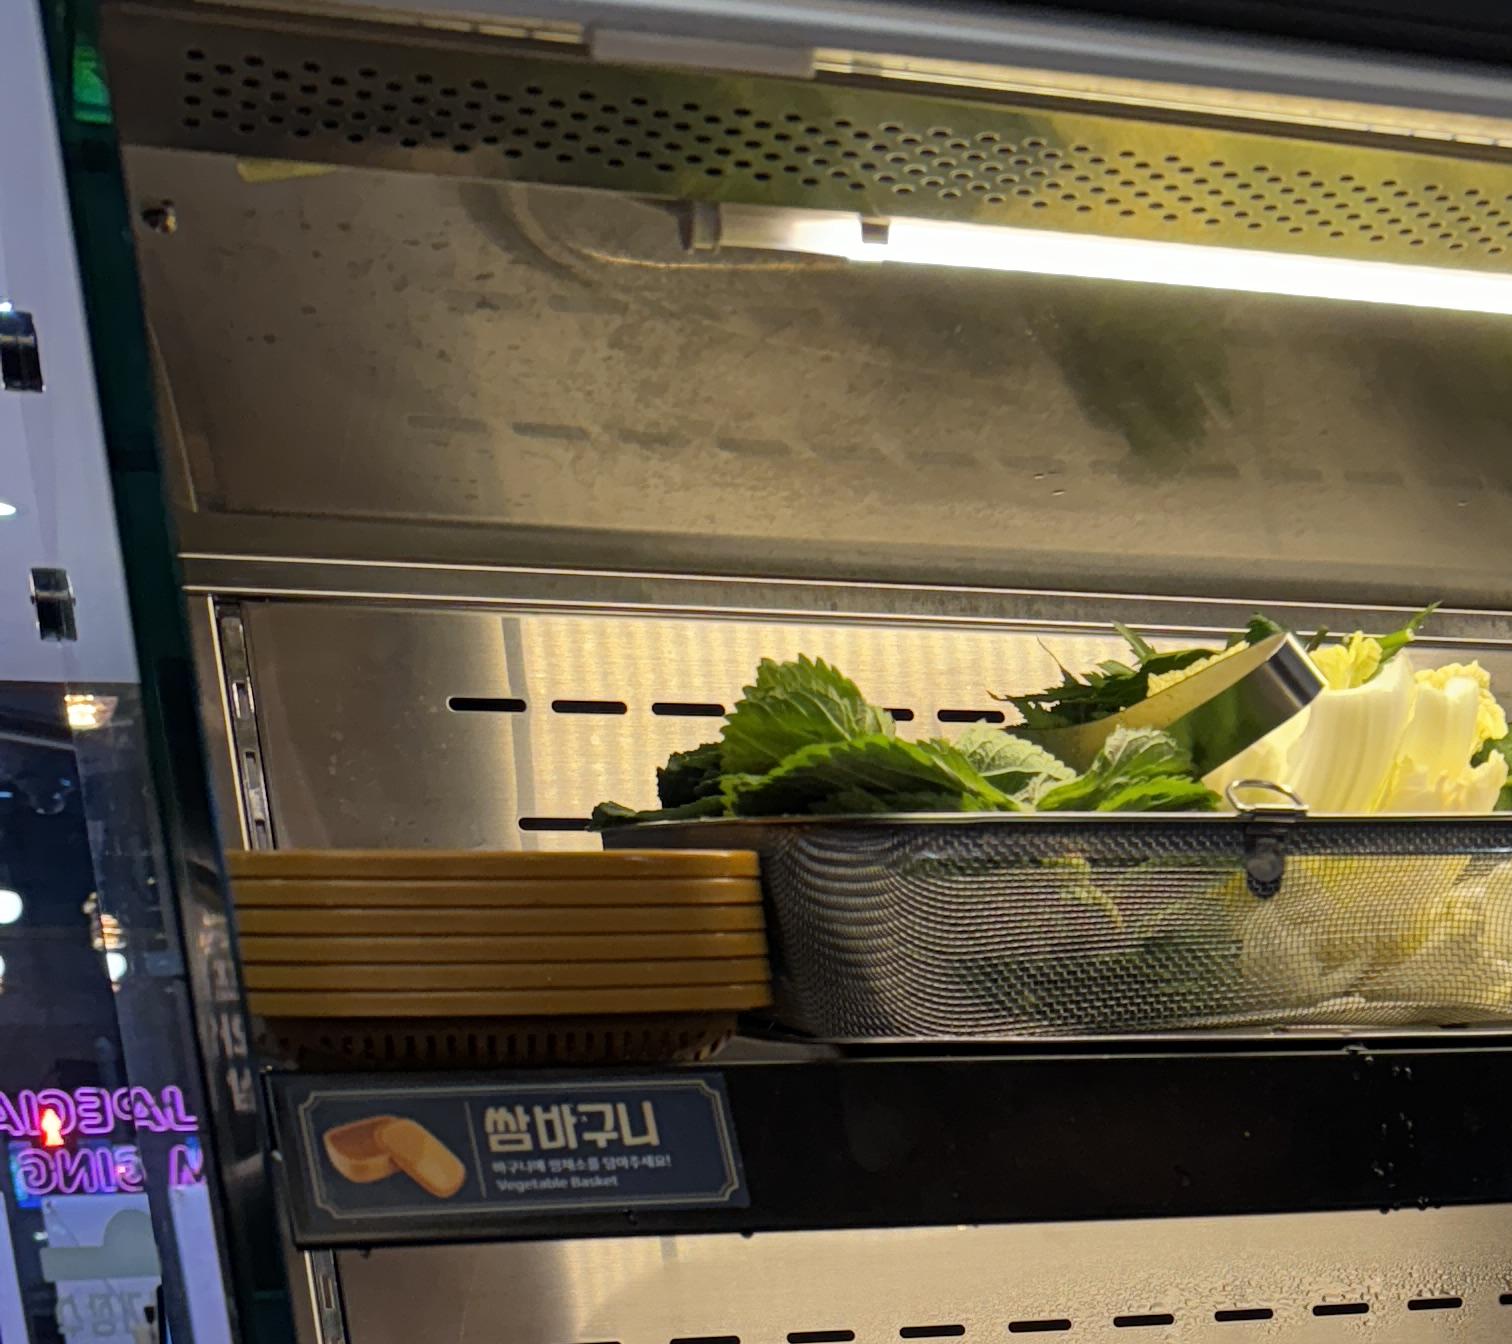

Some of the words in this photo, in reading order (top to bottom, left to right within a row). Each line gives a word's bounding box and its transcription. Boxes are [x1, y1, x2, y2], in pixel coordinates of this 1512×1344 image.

[484, 1099, 661, 1152] 쌈바구니
[497, 1178, 568, 1194] Vegetable
[570, 1175, 618, 1188] Basket
